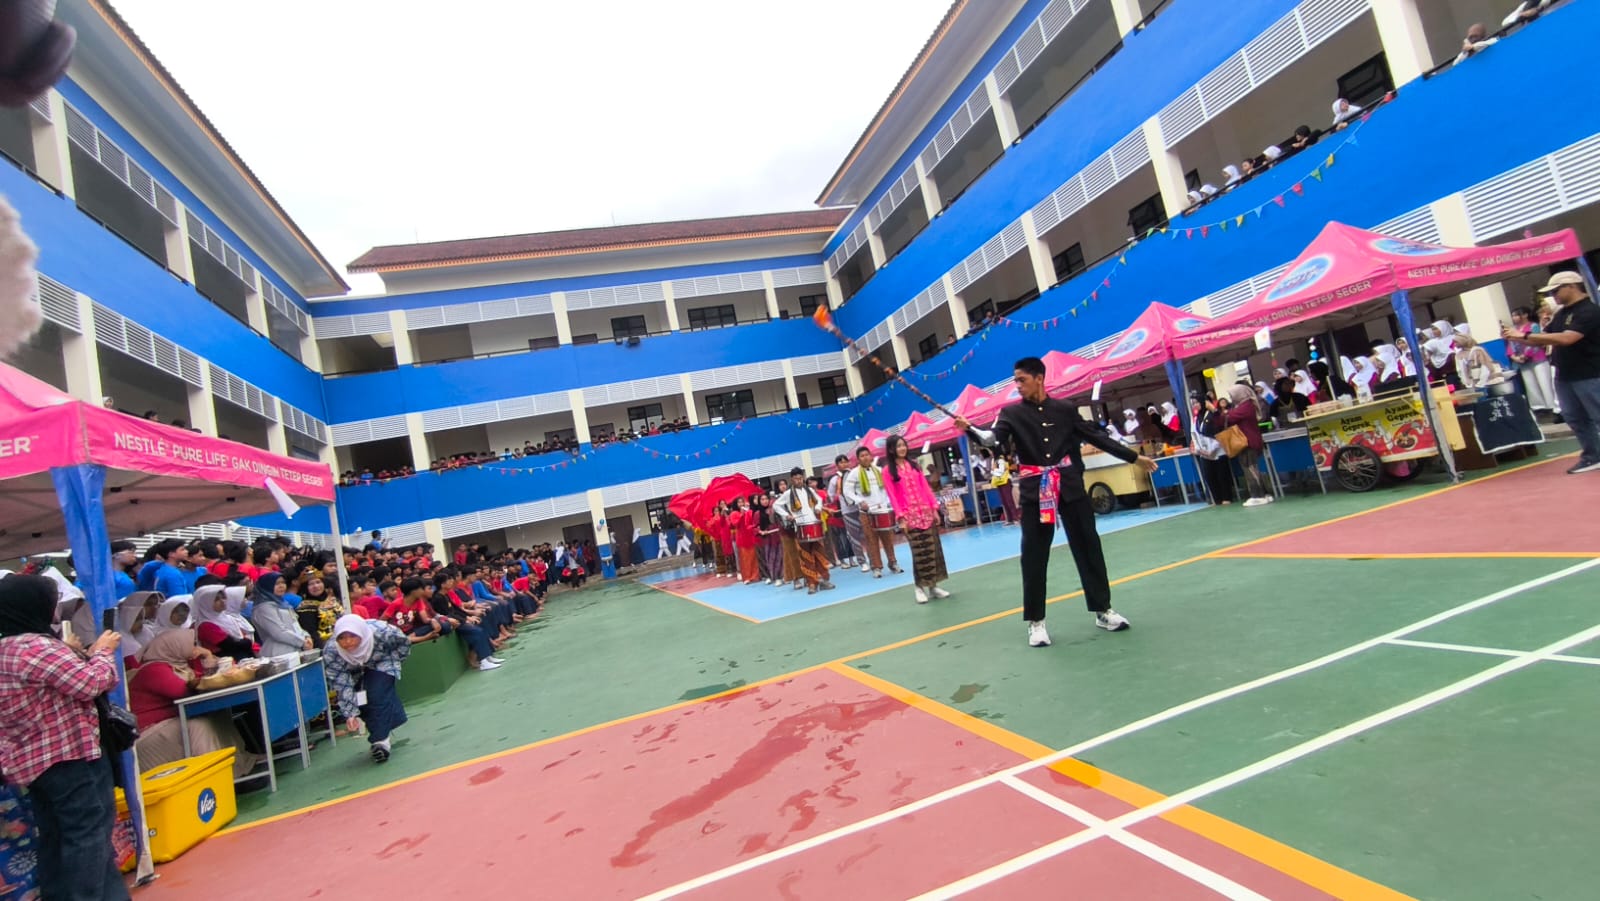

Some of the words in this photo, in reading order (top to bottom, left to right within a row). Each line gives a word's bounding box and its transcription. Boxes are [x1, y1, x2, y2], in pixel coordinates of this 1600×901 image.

[1304, 293, 1334, 309] TETEP
[1335, 280, 1372, 298] SEGER
[1385, 403, 1410, 415] Ayam
[1386, 409, 1419, 421] Geprek
[1341, 415, 1362, 425] Ayam
[172, 444, 203, 463] PURE
[205, 450, 228, 467] LIFE
[231, 456, 251, 472] GAK
[252, 461, 280, 478] DINGIN
